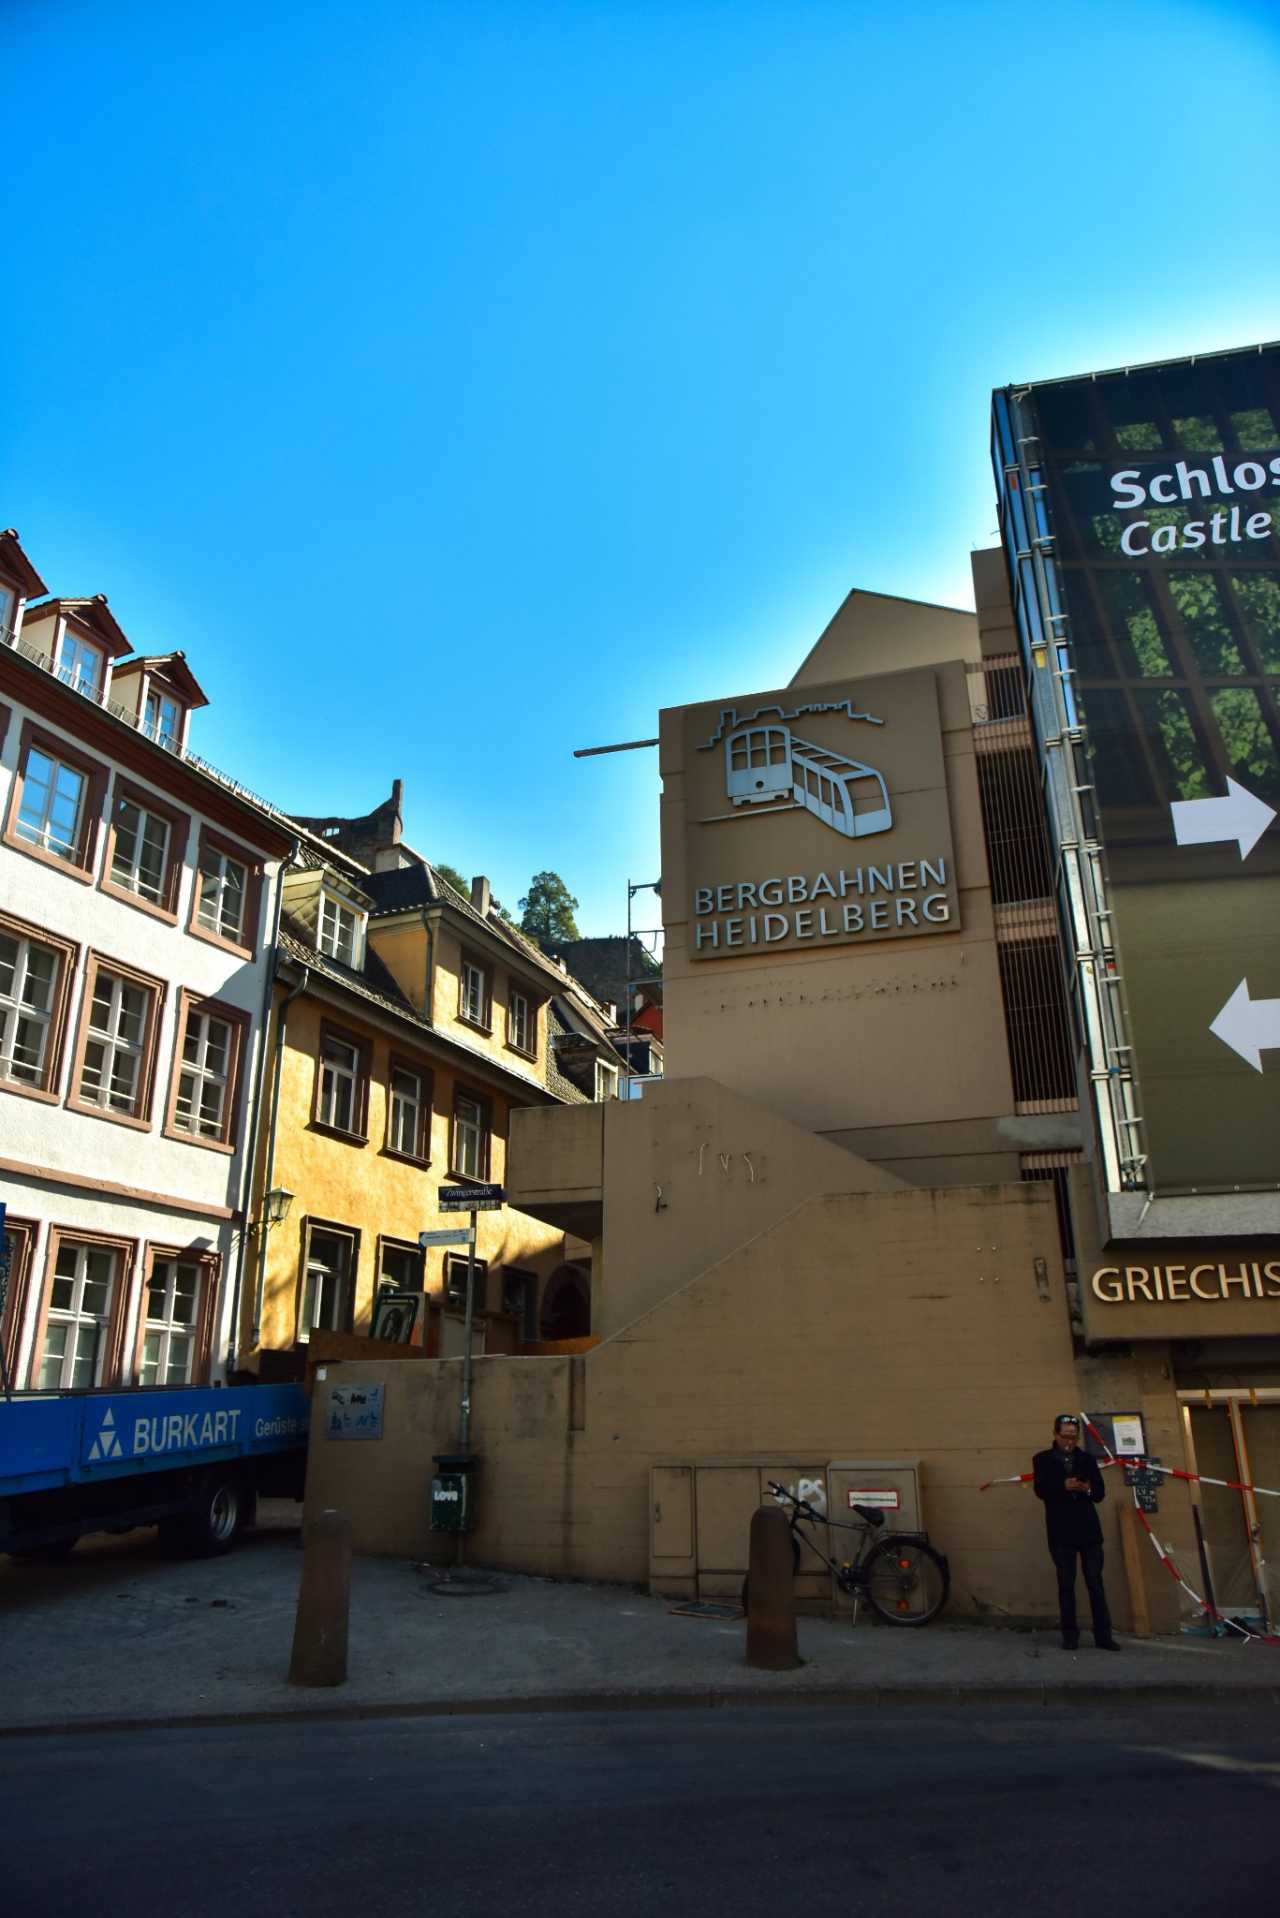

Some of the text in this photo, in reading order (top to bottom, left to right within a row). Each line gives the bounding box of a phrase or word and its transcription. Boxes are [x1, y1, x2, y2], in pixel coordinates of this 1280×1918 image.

[1121, 507, 1272, 556] Castle
[695, 857, 946, 916] BERGBAHNEN
[695, 893, 950, 949] HEIDELBERG
[133, 1409, 241, 1454] BURKART
